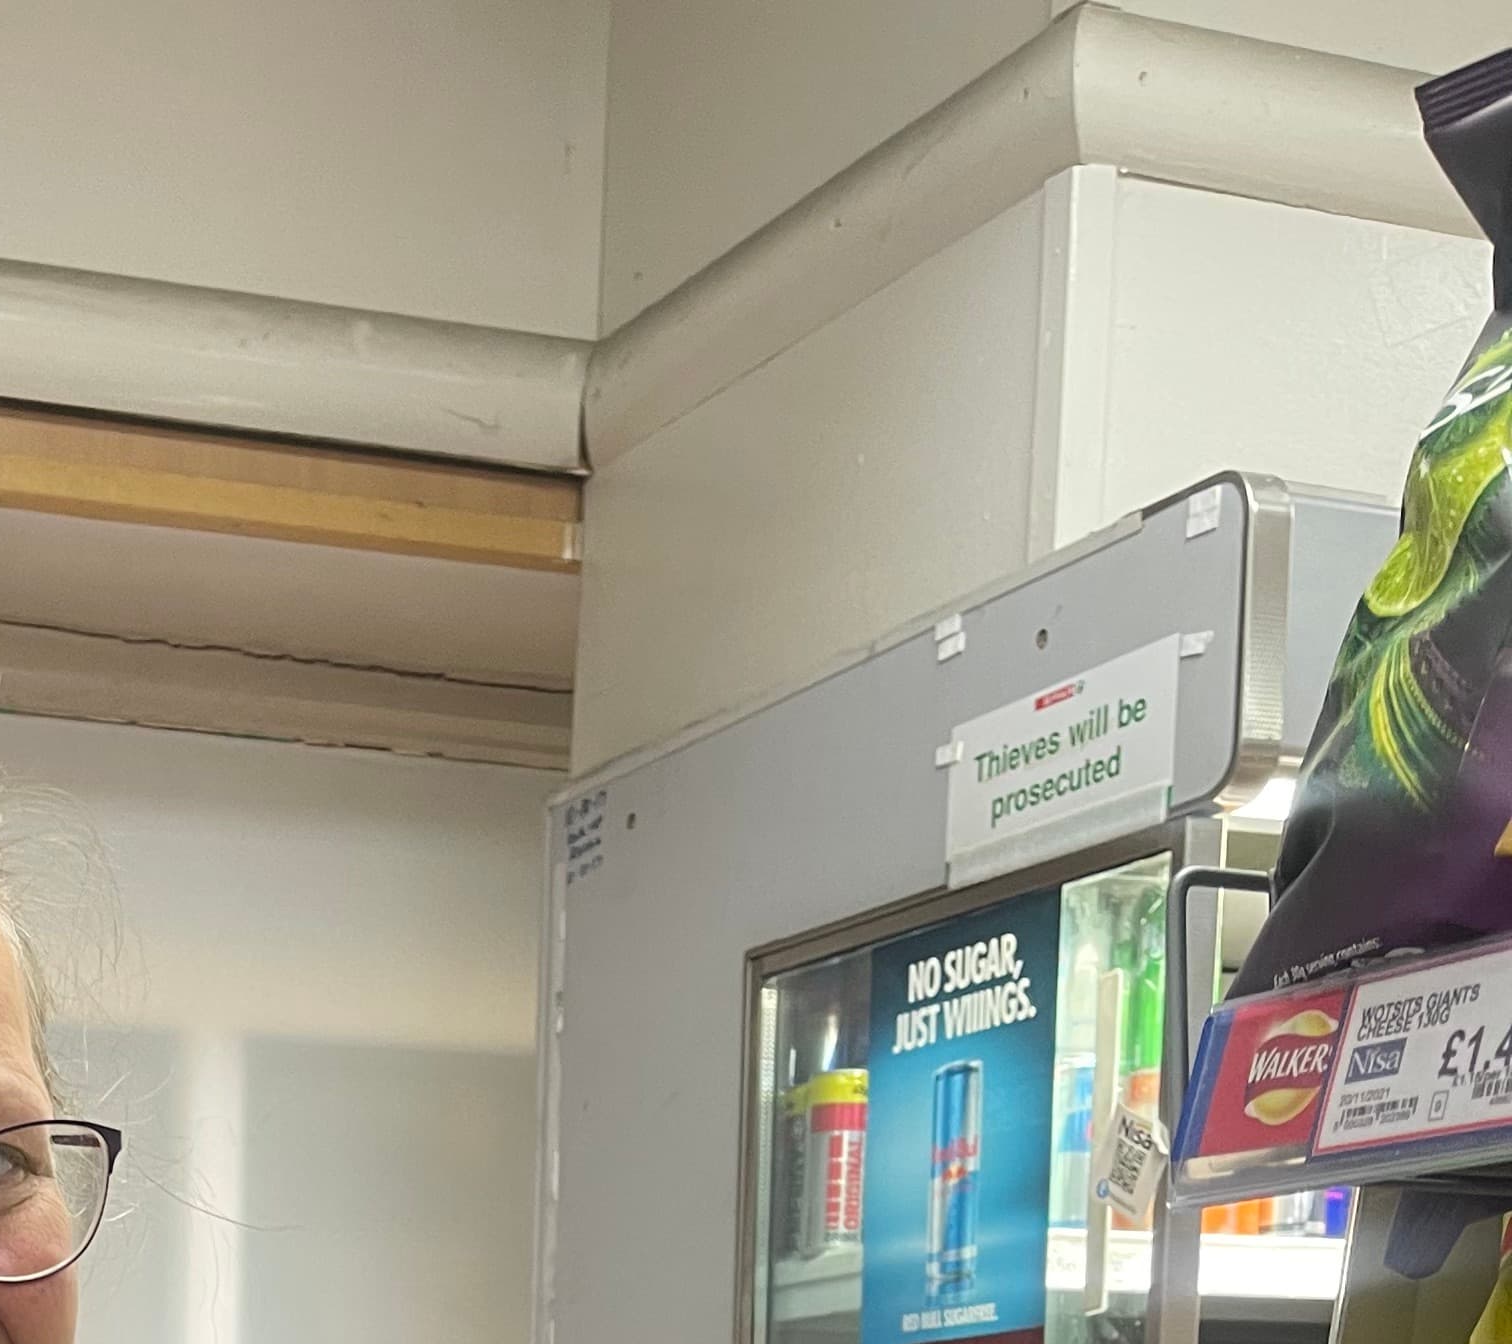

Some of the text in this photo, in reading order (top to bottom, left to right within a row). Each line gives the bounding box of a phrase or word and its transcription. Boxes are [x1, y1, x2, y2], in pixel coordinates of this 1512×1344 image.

[974, 732, 1060, 783] Thieves
[1068, 704, 1109, 747] will
[1117, 698, 1147, 728] be
[991, 744, 1121, 829] prosecuted
[908, 932, 1024, 1003] NO SUGAR,
[892, 1004, 940, 1054] JUST
[1357, 1016, 1412, 1042] CHEESE
[1362, 983, 1481, 1028] WOTSITS GIANTS
[1348, 1047, 1402, 1079] Nisa
